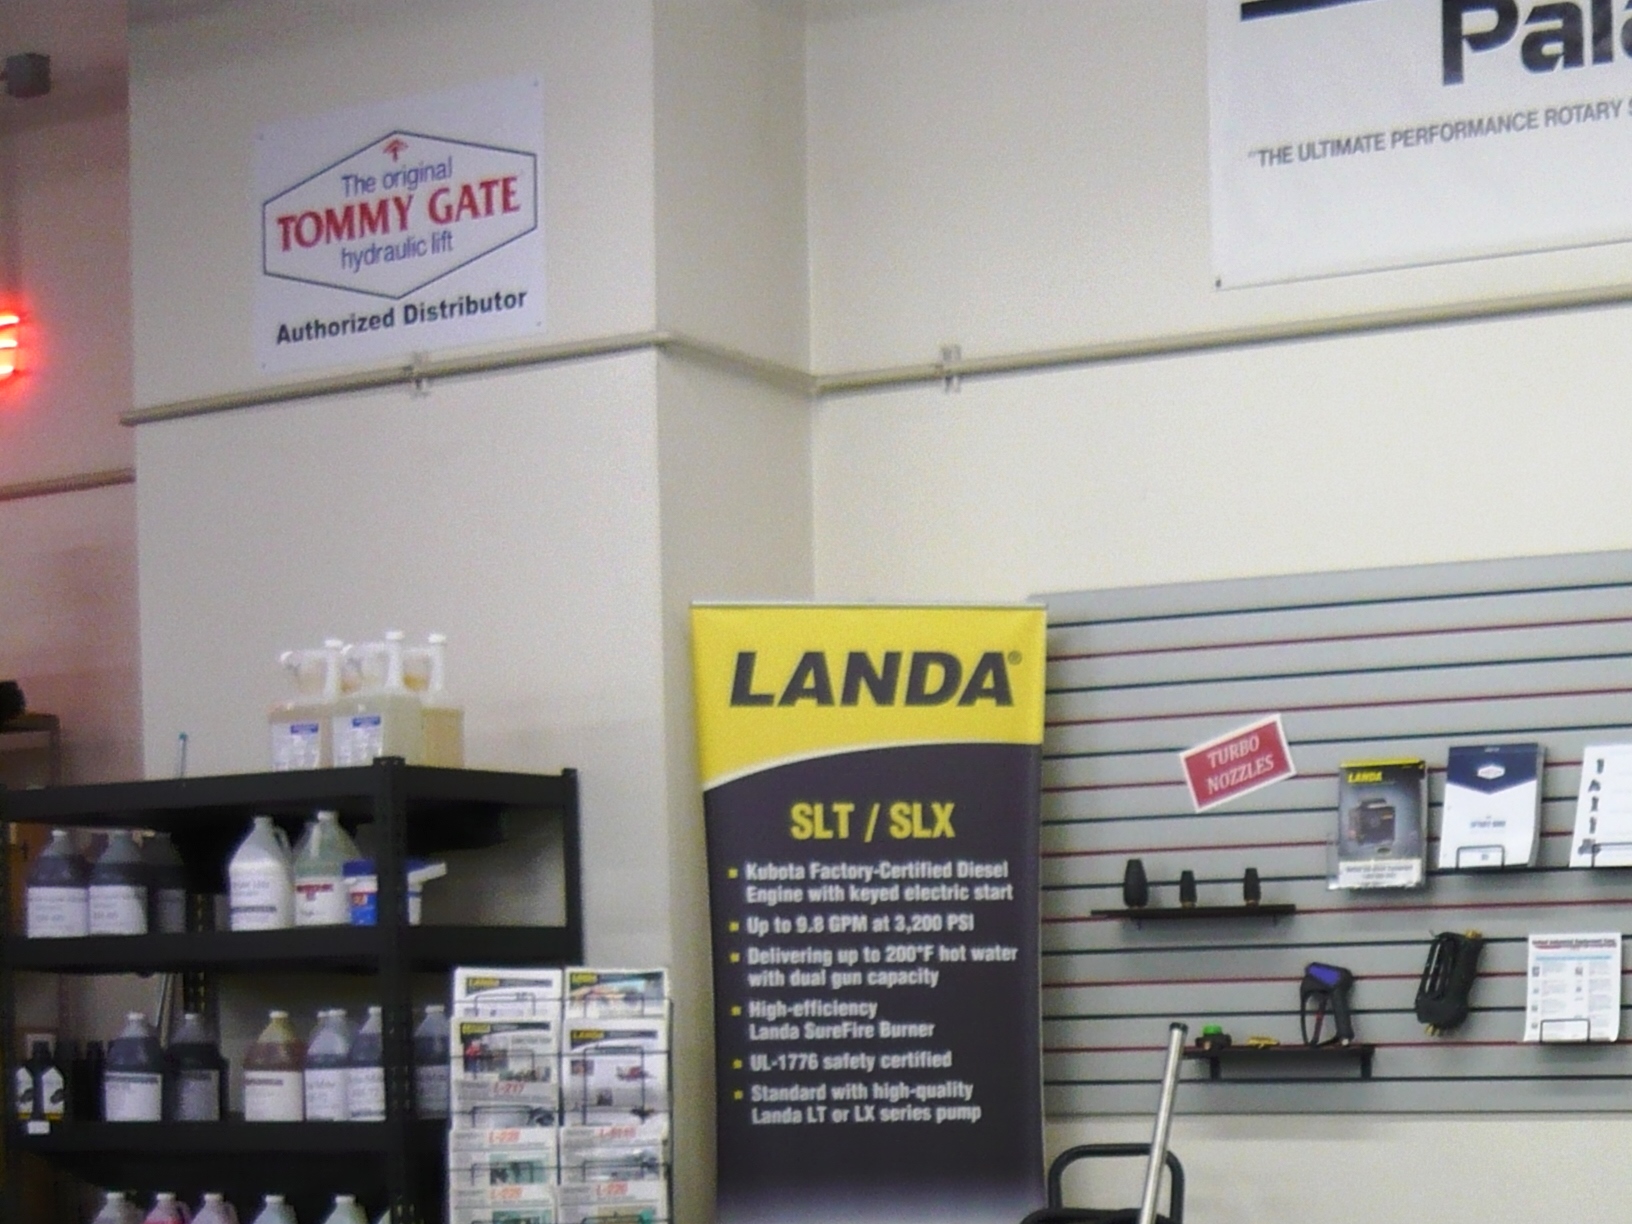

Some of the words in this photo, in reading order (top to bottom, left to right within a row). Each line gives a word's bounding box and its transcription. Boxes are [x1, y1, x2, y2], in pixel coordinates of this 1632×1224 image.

[1298, 133, 1386, 163] ULTIMATE
[1391, 111, 1539, 149] PERFORMANCE
[1544, 102, 1623, 129] ROTARY
[341, 175, 376, 197] The
[383, 156, 452, 190] original
[277, 194, 413, 252] TOMMY
[428, 176, 521, 225] GATE
[341, 237, 427, 273] hydraulic
[431, 231, 453, 254] lift
[276, 308, 394, 345] Authorized
[403, 291, 527, 326] Distributor
[729, 651, 1014, 707] LANDA
[1207, 734, 1260, 769] TURBO
[1206, 754, 1275, 795] NOZZLES
[790, 802, 855, 840] SLT
[889, 802, 956, 839] SLX
[745, 862, 805, 881] Kubota
[810, 861, 953, 883] Factory-Certified
[956, 860, 1009, 879] Diesel
[746, 885, 803, 906] Engine
[807, 885, 845, 902] with
[849, 884, 900, 905] keyed
[904, 883, 970, 901] electric
[973, 883, 1014, 900] start
[746, 916, 769, 937] Up
[774, 917, 791, 934] to
[828, 915, 868, 933] GPM
[872, 916, 890, 932] at
[947, 913, 974, 932] PSI
[747, 947, 833, 967] Delivering
[837, 949, 859, 967] up
[863, 947, 881, 963] to
[938, 945, 967, 963] hot
[971, 945, 1018, 963] water
[748, 970, 785, 988] with
[789, 970, 827, 987] dual
[831, 972, 862, 990] gun
[867, 968, 939, 989] capacity
[749, 1001, 878, 1022] High-efficiency
[749, 1023, 800, 1041] Landa
[804, 1022, 874, 1040] SureFire
[879, 1022, 936, 1039] Burner
[823, 1053, 876, 1072] safety
[880, 1051, 952, 1070] certified
[751, 1085, 827, 1102] Standard
[831, 1084, 868, 1101] with
[873, 1082, 974, 1103] high-quality
[752, 1107, 802, 1126] Landa
[807, 1106, 827, 1123] LT
[832, 1108, 849, 1123] or
[854, 1106, 876, 1123] LX
[880, 1104, 932, 1122] series
[936, 1105, 982, 1124] pump
